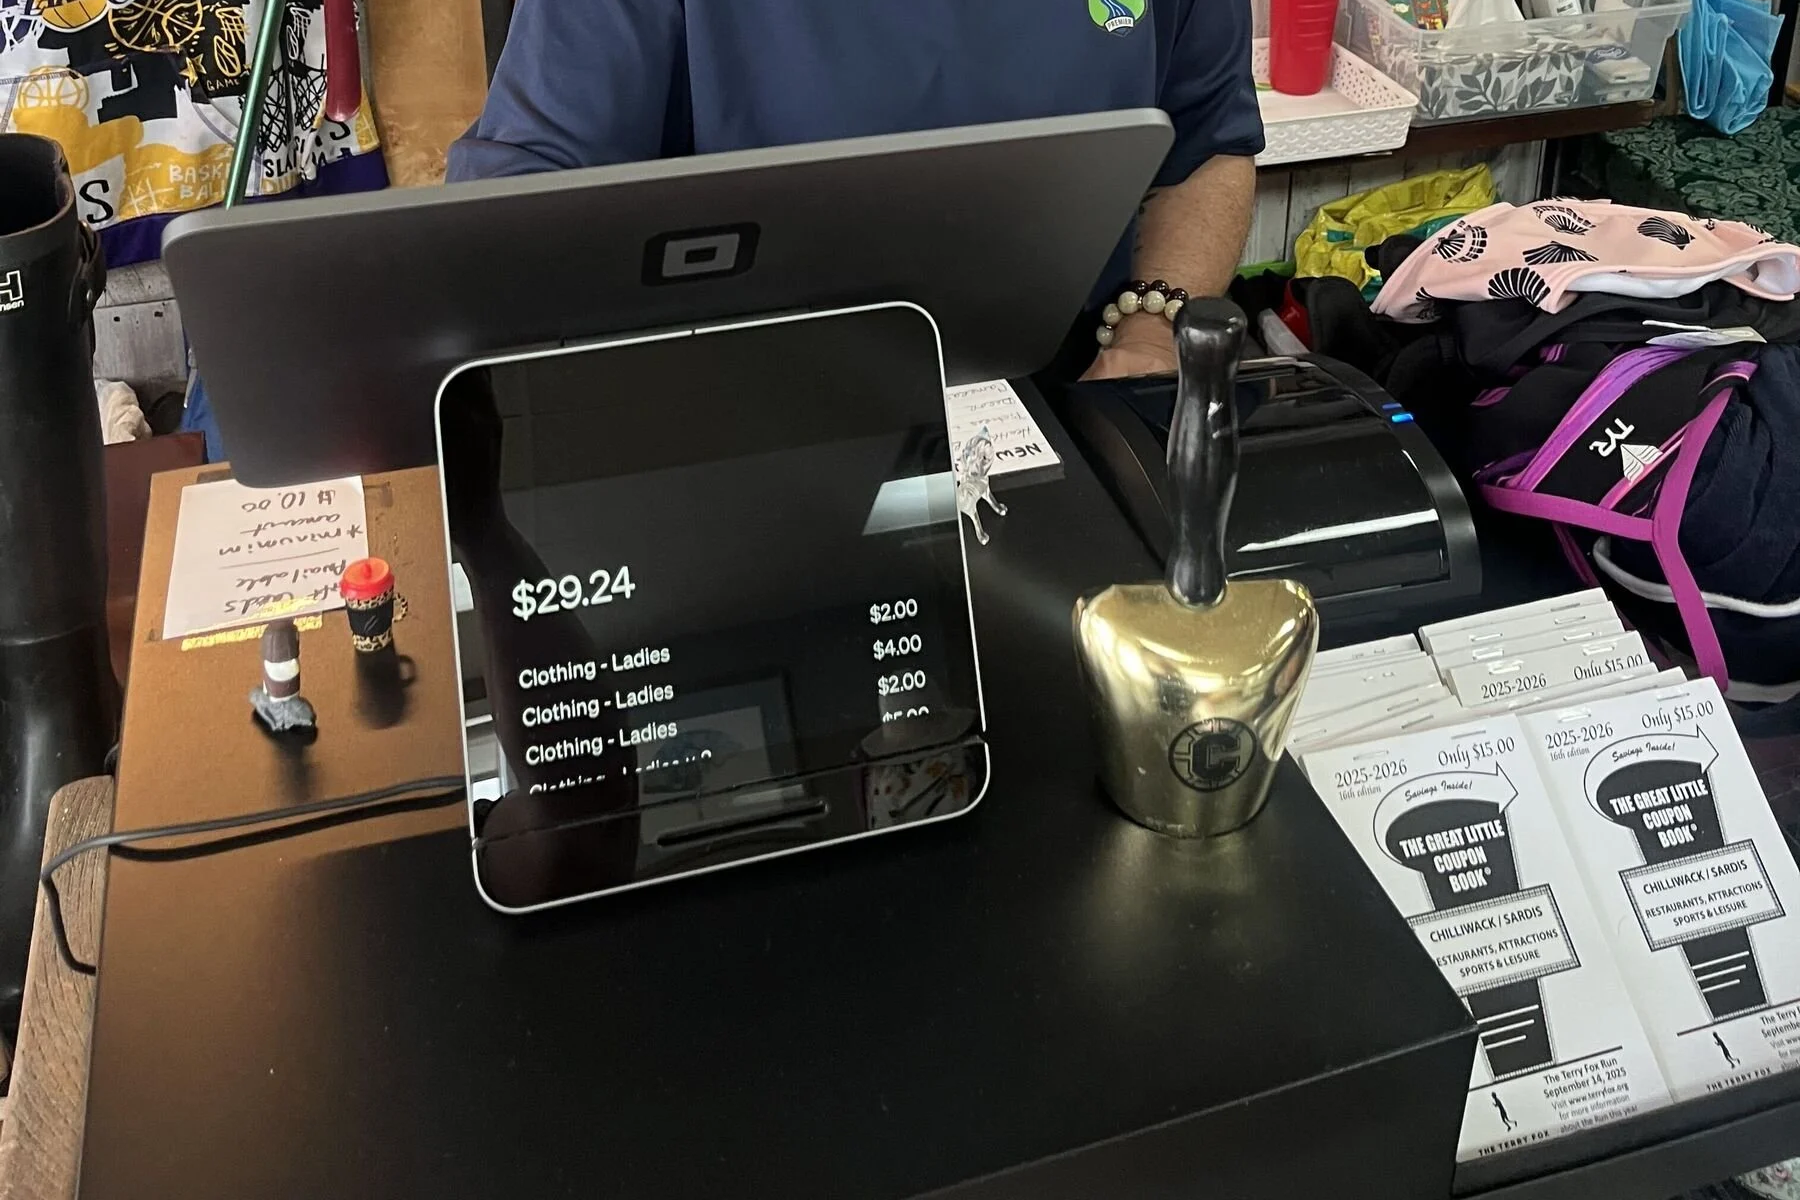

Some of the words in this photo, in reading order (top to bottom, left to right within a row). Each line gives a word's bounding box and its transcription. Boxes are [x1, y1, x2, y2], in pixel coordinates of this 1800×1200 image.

[995, 443, 1042, 460] NEW
[512, 566, 636, 621] $29.24
[869, 598, 918, 625] $2.00
[873, 634, 922, 661] $4.00
[519, 660, 597, 689] Clothing
[611, 647, 670, 672] Ladies
[877, 670, 926, 696] $2.00
[1481, 672, 1547, 699] 2025-2026
[522, 699, 600, 727] Clothing
[615, 684, 674, 709] Ladies
[1545, 722, 1614, 749] 2025-2026
[1641, 707, 1673, 732] Only
[1674, 699, 1715, 724] $15.00
[525, 736, 603, 765] Clothing
[619, 721, 678, 747] Ladies
[1549, 749, 1566, 762] 16th
[1566, 746, 1591, 759] edition
[1611, 745, 1643, 763] Savings
[1645, 742, 1676, 753] Inside!
[1334, 759, 1408, 788] 2025-2026
[1437, 746, 1471, 769] Only
[1472, 736, 1515, 760] $15.00
[1338, 788, 1355, 801] 16th
[1356, 784, 1382, 799] edition
[1404, 782, 1438, 802] Savings
[1441, 779, 1474, 793] Inside!
[1609, 796, 1635, 816] THE
[1635, 787, 1670, 811] GREAT
[1670, 778, 1709, 801] LITTLE
[1642, 803, 1694, 830] COUPON
[1399, 836, 1426, 858] THE
[1425, 827, 1464, 854] GREAT
[1464, 819, 1505, 843] LITTLE
[1433, 845, 1487, 874] COUPON
[1643, 869, 1704, 895] CHILLIWACK
[1711, 859, 1748, 878] SARDIS
[1645, 895, 1707, 919] RESTAURANTS,
[1708, 880, 1763, 902] ATTRACTIONS
[1673, 910, 1706, 927] SPORTS
[1714, 899, 1748, 917] LEISURE
[1429, 915, 1497, 943] CHILLIWACK
[1503, 905, 1543, 926] SARDIS
[1434, 944, 1499, 968] ESTAURANTS,
[1499, 928, 1559, 951] ATTRACTIONS
[1459, 961, 1495, 978] SPORTS
[1503, 948, 1541, 967] LEISURE
[1760, 1014, 1776, 1026] The
[1776, 1008, 1797, 1021] Terry
[1543, 1074, 1560, 1086] The
[1561, 1067, 1583, 1081] Terry
[1584, 1061, 1599, 1074] Fox
[1600, 1057, 1618, 1070] Run
[1543, 1079, 1590, 1099] September
[1591, 1073, 1606, 1085] 14,
[1606, 1066, 1627, 1082] 2025
[1551, 1099, 1567, 1111] Visit
[1568, 1082, 1629, 1105] www.terryfox.org
[1559, 1110, 1570, 1121] for
[1570, 1106, 1590, 1118] more
[1590, 1093, 1630, 1112] information
[1560, 1121, 1581, 1133] about
[1581, 1117, 1594, 1129] the
[1594, 1114, 1609, 1125] Run
[1609, 1110, 1623, 1121] this
[1478, 1143, 1496, 1157] THE
[1499, 1136, 1528, 1151] TERRY
[1532, 1129, 1550, 1141] FOX
